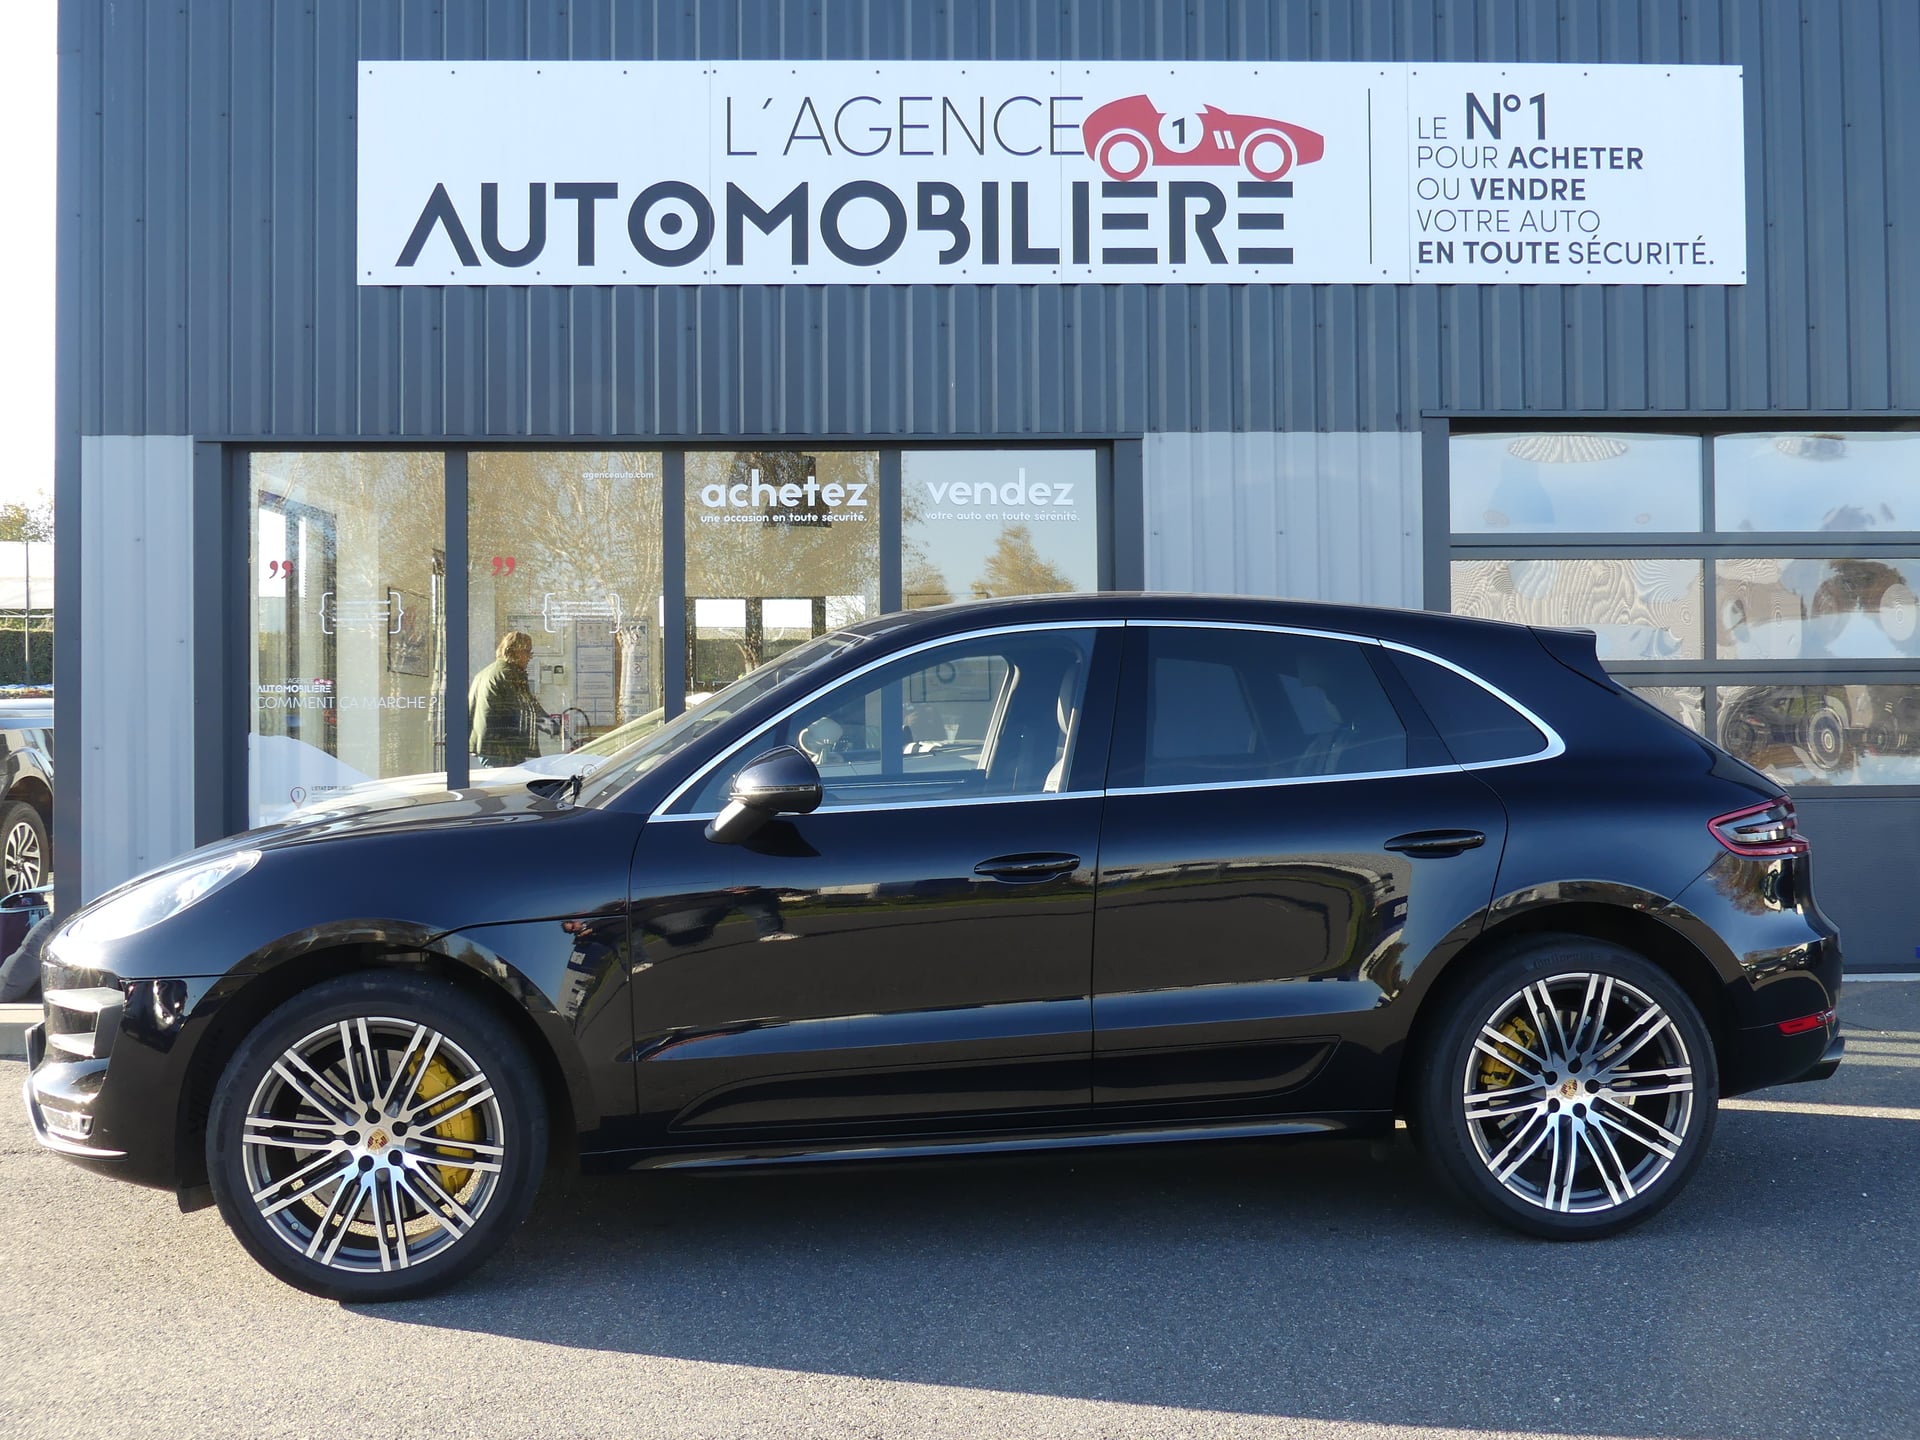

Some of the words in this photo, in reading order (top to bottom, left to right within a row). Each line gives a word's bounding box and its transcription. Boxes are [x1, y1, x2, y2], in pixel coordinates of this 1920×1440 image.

[1171, 117, 1186, 145] 1
[1417, 116, 1448, 140] LE
[1417, 145, 1499, 169] POUR
[1507, 146, 1644, 170] ACHETER
[1416, 176, 1460, 201] OU
[1469, 177, 1586, 201] VENDRE
[1416, 208, 1511, 233] VOTRE
[1519, 209, 1601, 234] AUTO
[1418, 241, 1454, 264] EN
[1463, 241, 1560, 265] TOUTE
[1568, 234, 1715, 266] SÉCURITÉ.
[583, 471, 654, 480] agenceauto.com
[700, 468, 868, 508] achetez
[925, 467, 1075, 506] vendez
[700, 514, 721, 523] une
[723, 512, 769, 523] occasion
[772, 514, 786, 523] en
[788, 512, 818, 523] toute
[821, 511, 868, 523] sécurité.
[925, 510, 953, 521] votre
[956, 511, 982, 521] auto
[985, 512, 999, 521] en
[1002, 511, 1031, 521] toute
[256, 696, 336, 709] COMMENT
[363, 697, 427, 710] MARCHE
